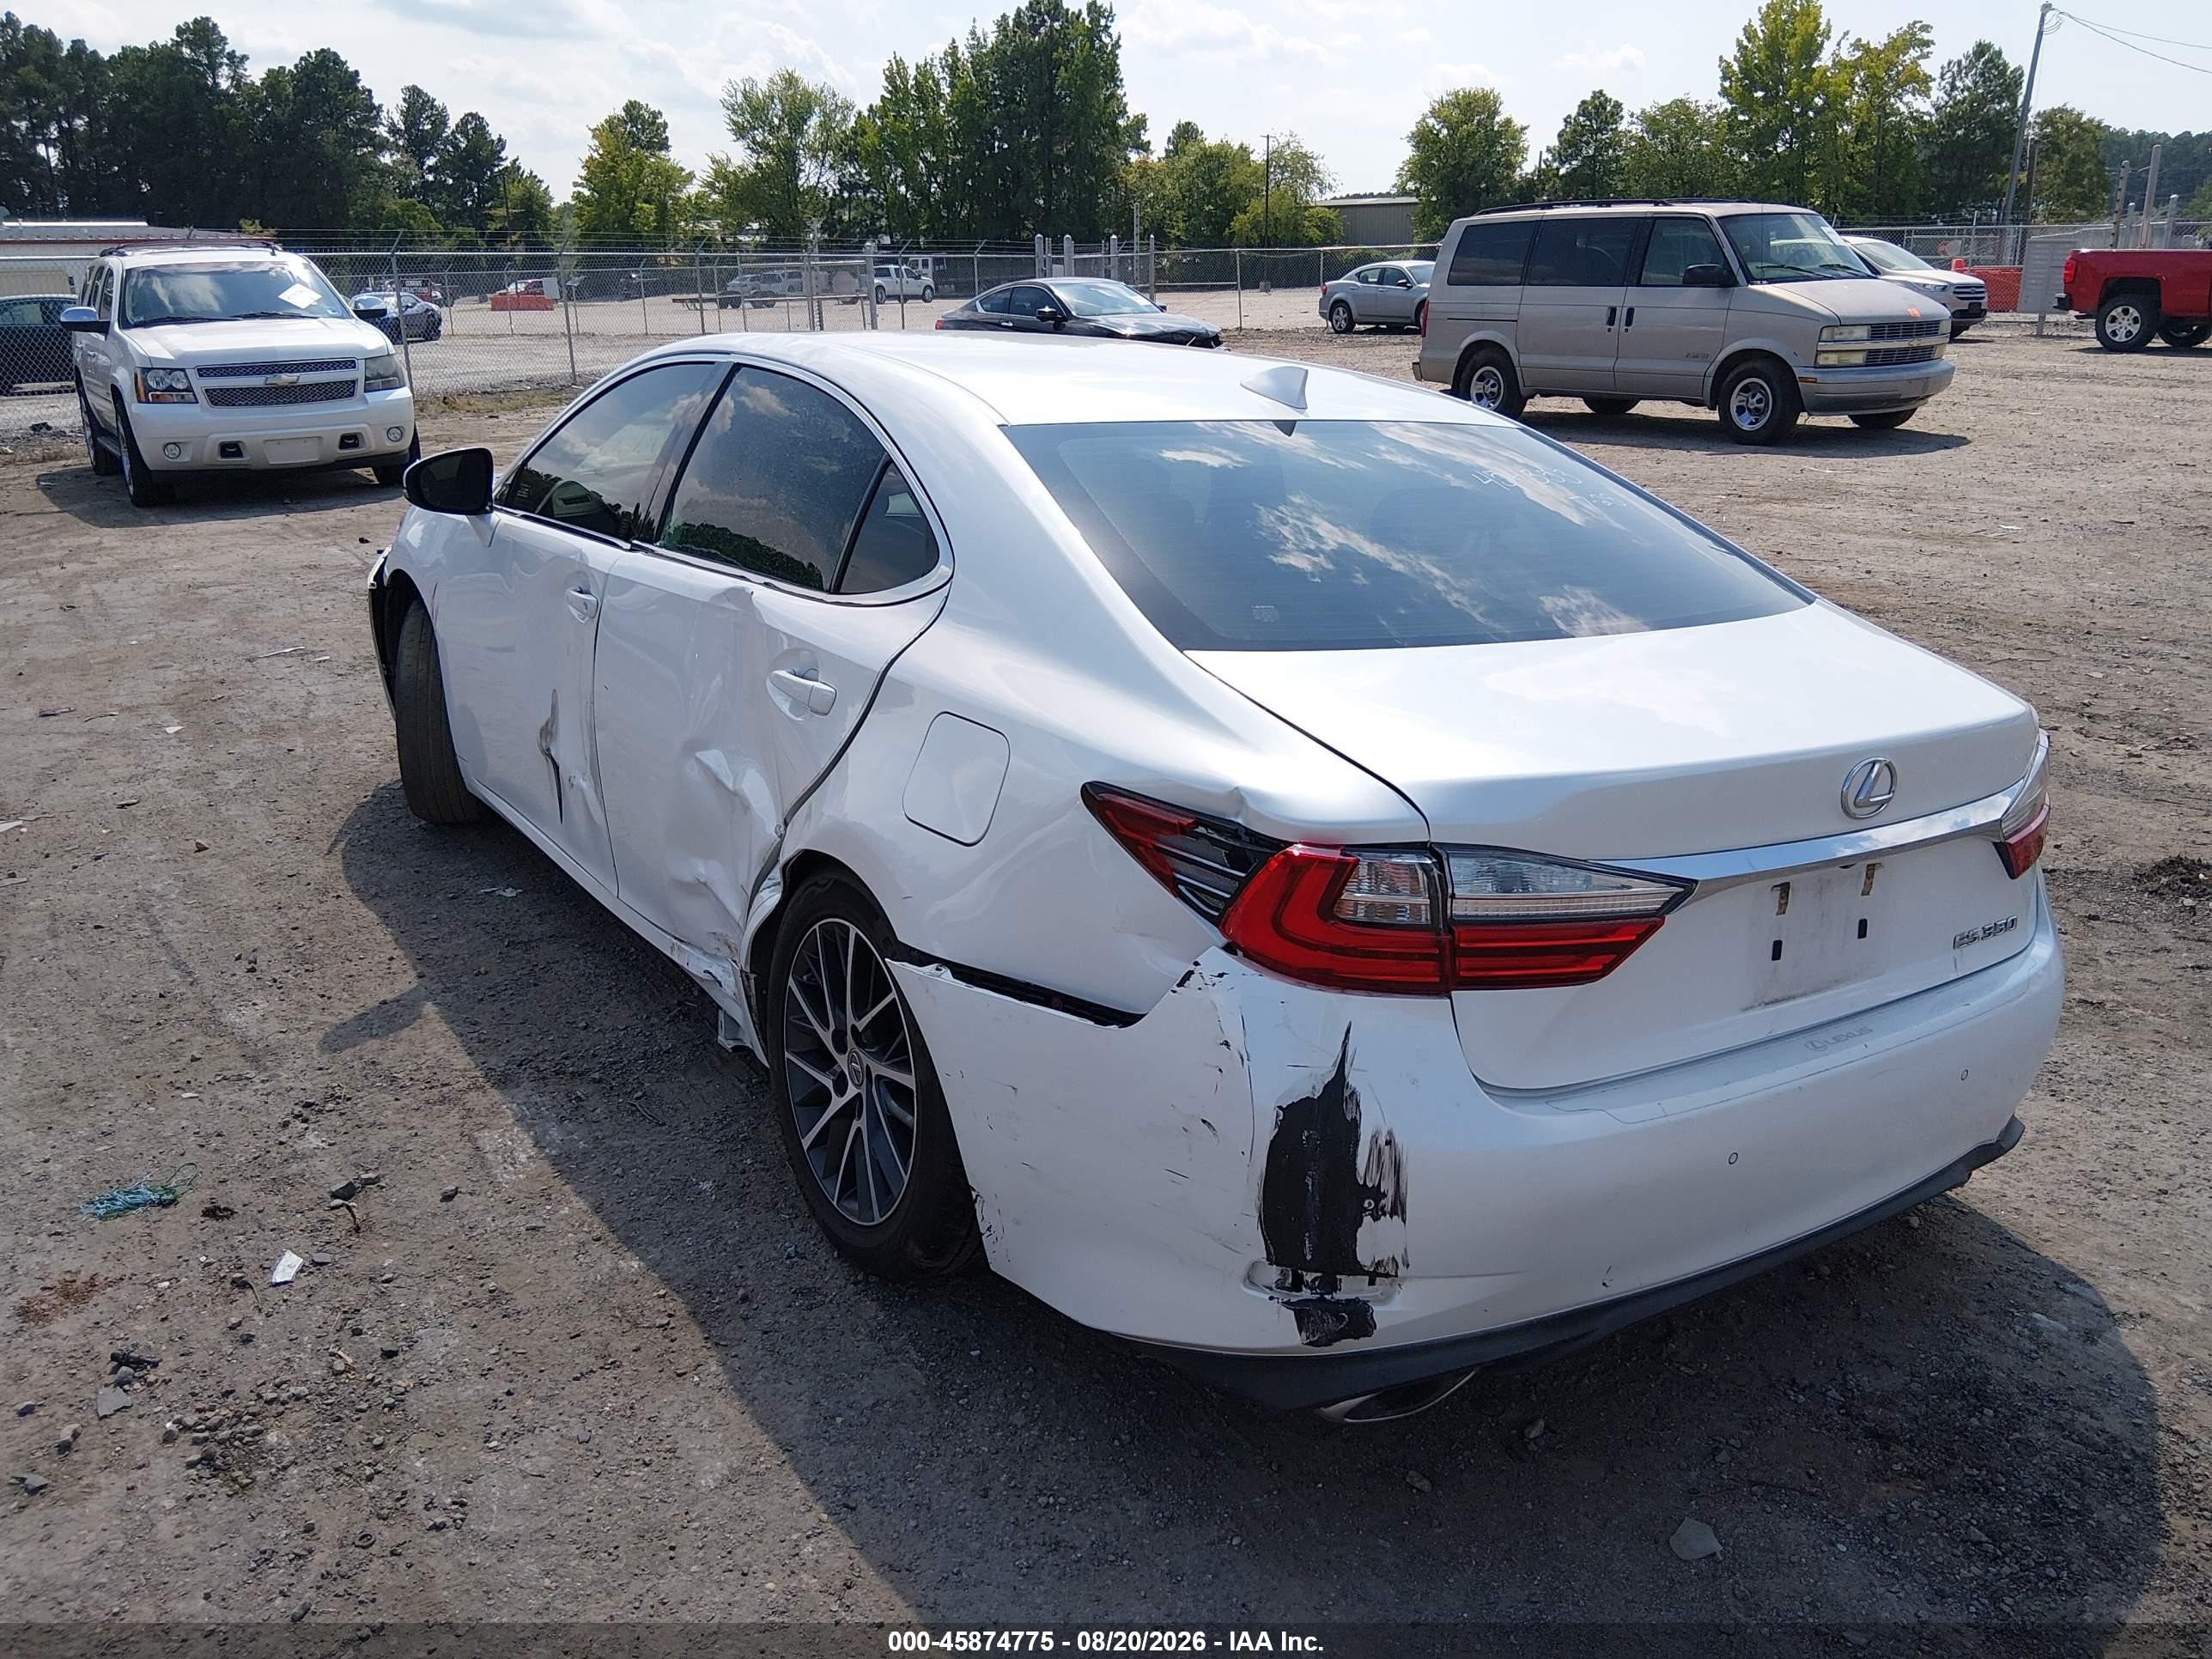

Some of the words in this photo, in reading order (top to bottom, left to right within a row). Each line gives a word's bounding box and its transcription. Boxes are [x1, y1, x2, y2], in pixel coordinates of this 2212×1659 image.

[1953, 927, 1980, 950] ES
[1981, 915, 2019, 941] 350
[1823, 1026, 1874, 1045] LEXUS
